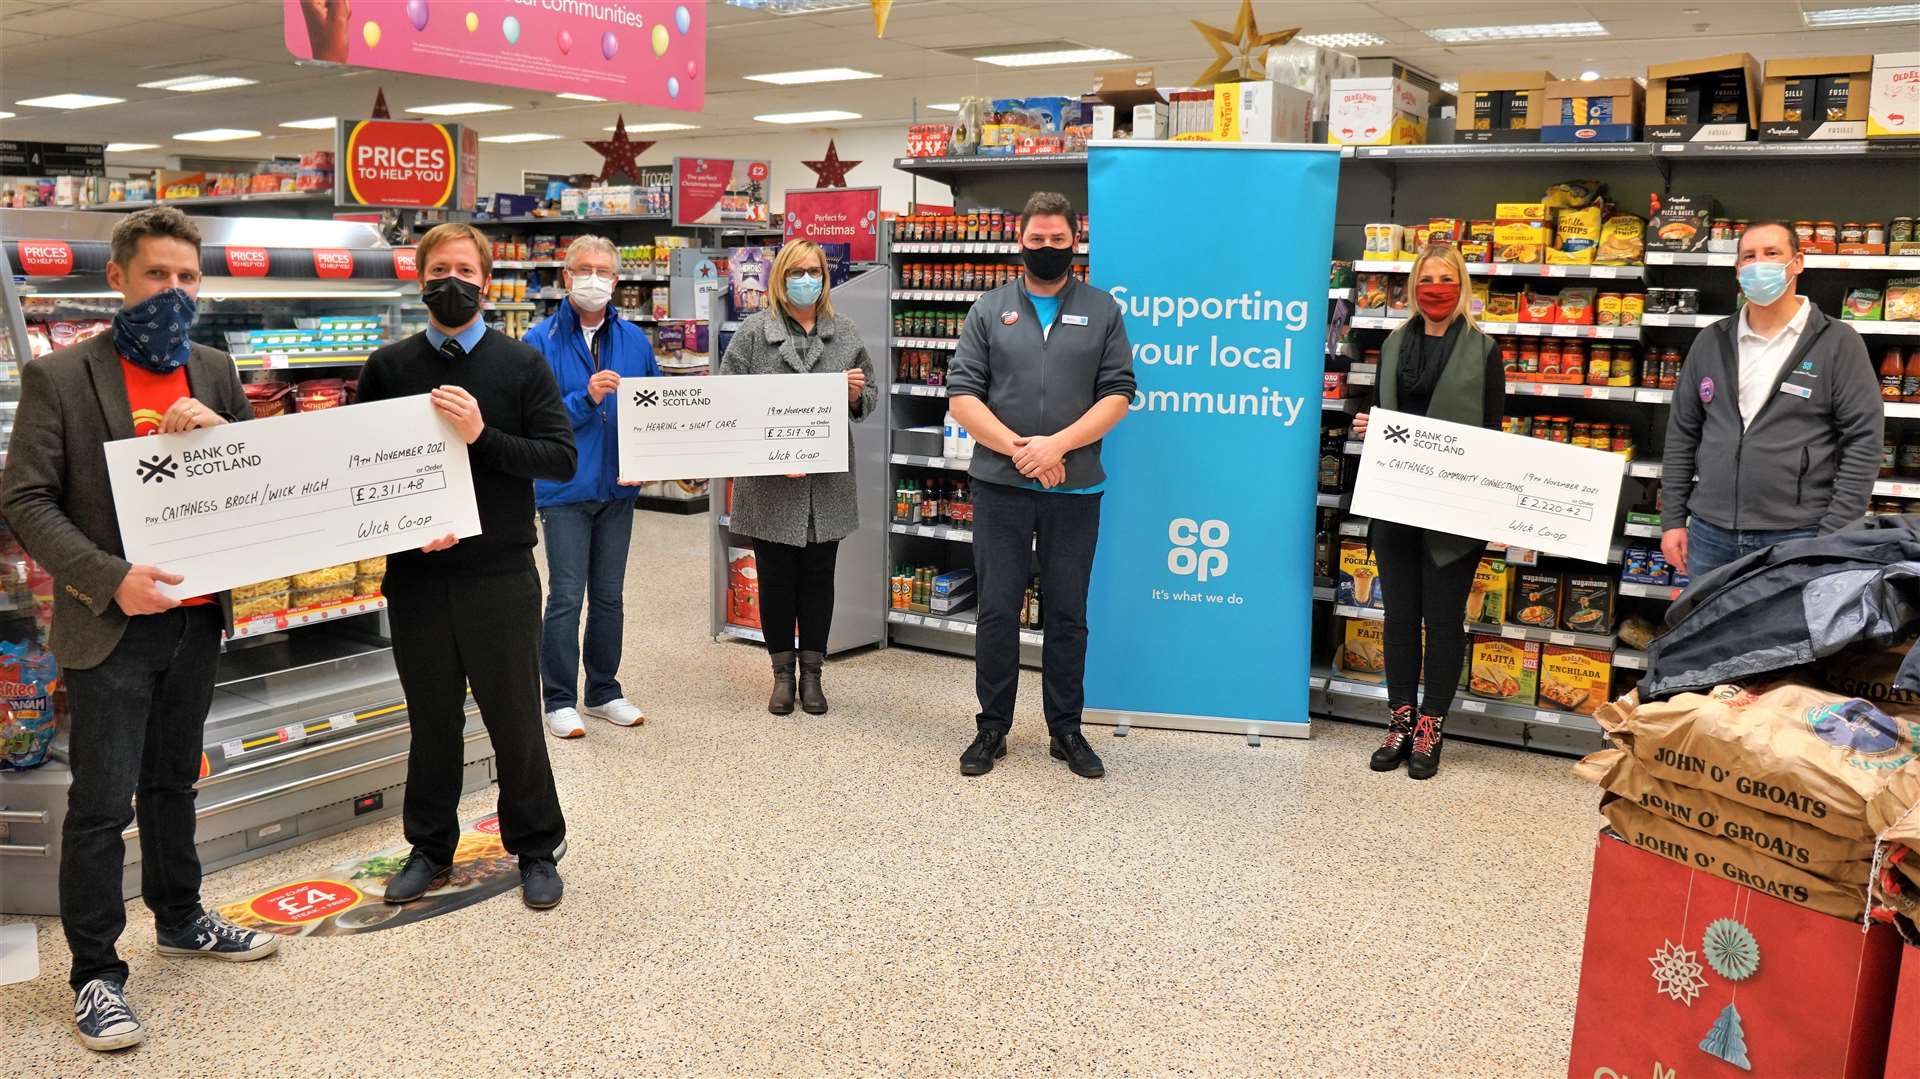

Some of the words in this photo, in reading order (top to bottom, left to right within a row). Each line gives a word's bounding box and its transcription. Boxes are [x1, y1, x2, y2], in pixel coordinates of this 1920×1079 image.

[541, 0, 643, 28] communities
[32, 153, 40, 165] 4
[358, 146, 445, 169] PRICES
[358, 168, 377, 179] TO
[380, 169, 412, 181] HELP
[414, 170, 444, 182] YOU
[814, 214, 837, 222] Perfect
[806, 224, 856, 236] Christmas
[24, 247, 68, 258] PRICES
[231, 250, 265, 262] PRICES
[318, 252, 350, 264] PRICES
[398, 256, 416, 265] PRIC
[1108, 286, 1309, 332] Supporting
[685, 324, 696, 335] 24
[1210, 336, 1292, 370] local
[662, 389, 688, 398] BANK
[690, 388, 702, 397] OF
[662, 397, 711, 407] SCOTLAND
[1128, 387, 1305, 427] ommunity
[645, 422, 678, 432] HEARING
[688, 420, 712, 430] SIGHT
[715, 419, 738, 429] CARE
[1414, 429, 1442, 442] BANK
[1444, 434, 1458, 444] OF
[183, 448, 223, 464] BANK
[226, 442, 246, 457] OF
[374, 446, 424, 464] NOVEMBER
[426, 441, 447, 455] 2021
[1413, 439, 1465, 456] SCOTLAND
[184, 454, 262, 478] SCOTLAND
[424, 463, 444, 473] Order
[1388, 458, 1435, 477] CAITHNESS
[1438, 468, 1480, 483] COMMUNITY
[160, 498, 219, 522] CAITHNESS
[301, 479, 330, 496] HIGH
[144, 514, 160, 526] Pay
[1491, 562, 1505, 573] NEW
[1522, 574, 1558, 584] wagamama
[1571, 579, 1608, 588] wagamama
[1152, 589, 1170, 600] It's
[1172, 590, 1202, 602] what
[1206, 594, 1224, 604] we
[1227, 594, 1244, 604] do
[1358, 628, 1382, 640] FAJI
[1480, 652, 1515, 665] FAJITA
[1550, 664, 1601, 678] ENCHILADA
[0, 682, 38, 697] RIBO
[1654, 747, 1706, 774] JOHN
[1710, 766, 1730, 782] O'
[1736, 776, 1827, 818] GROATS
[1638, 793, 1692, 822] JOHN
[1698, 811, 1718, 828] O'
[1724, 821, 1810, 864] GROATS
[1635, 832, 1688, 863] JOHN
[1695, 853, 1716, 870] O'
[1722, 863, 1810, 904] GROATS
[278, 888, 336, 916] £4
